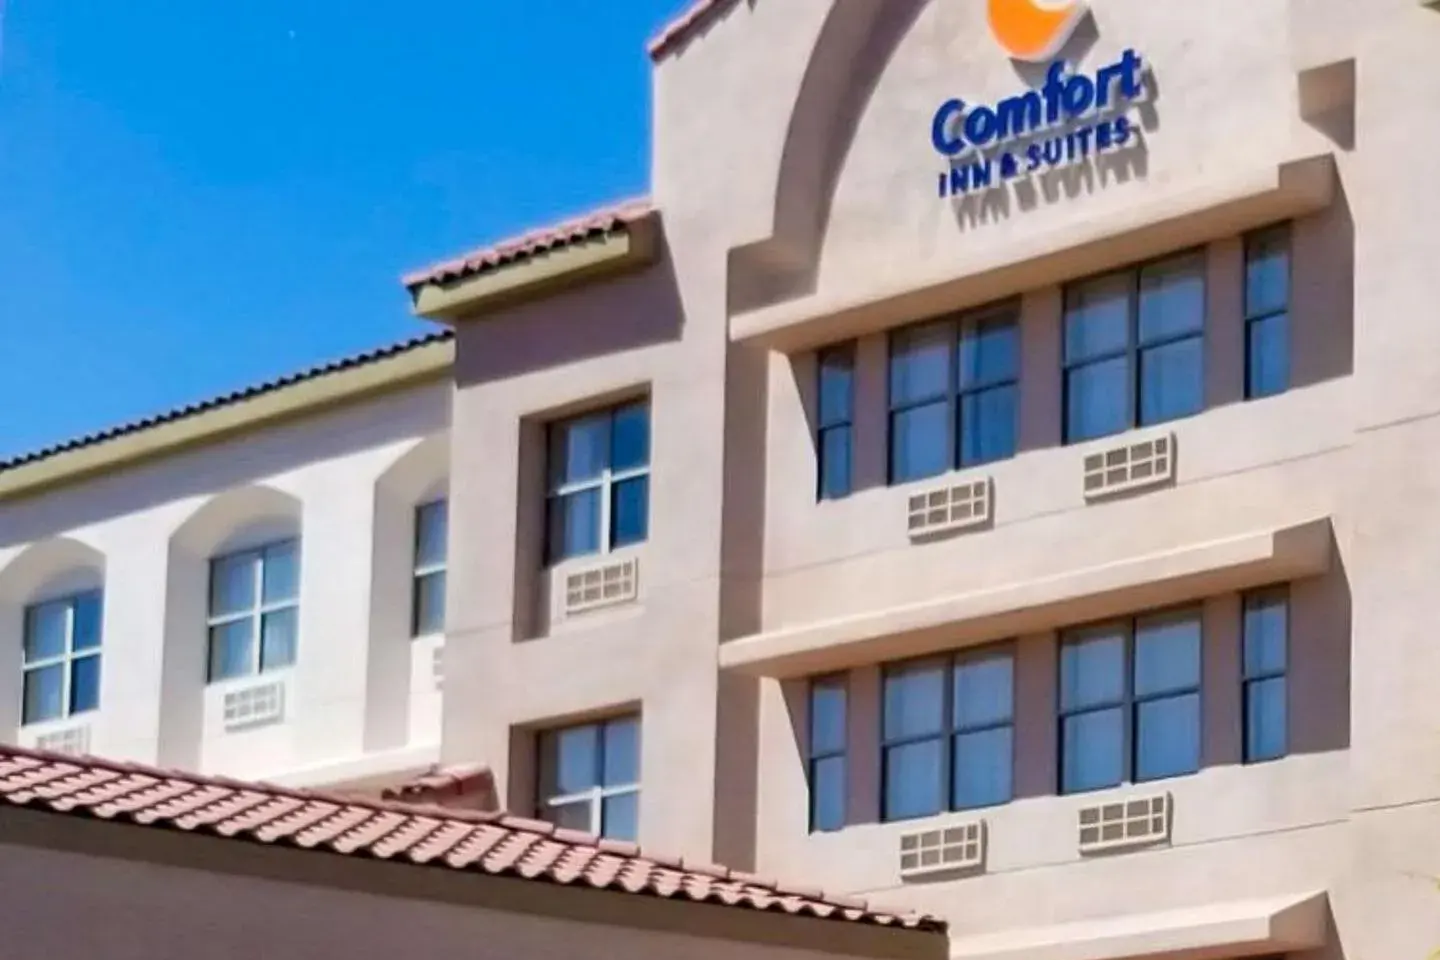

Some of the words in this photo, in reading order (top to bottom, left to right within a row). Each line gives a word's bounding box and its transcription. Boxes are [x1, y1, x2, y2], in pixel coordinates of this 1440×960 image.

[931, 48, 1142, 156] Comfort
[938, 157, 992, 198] INN
[1026, 115, 1131, 171] SUITES
